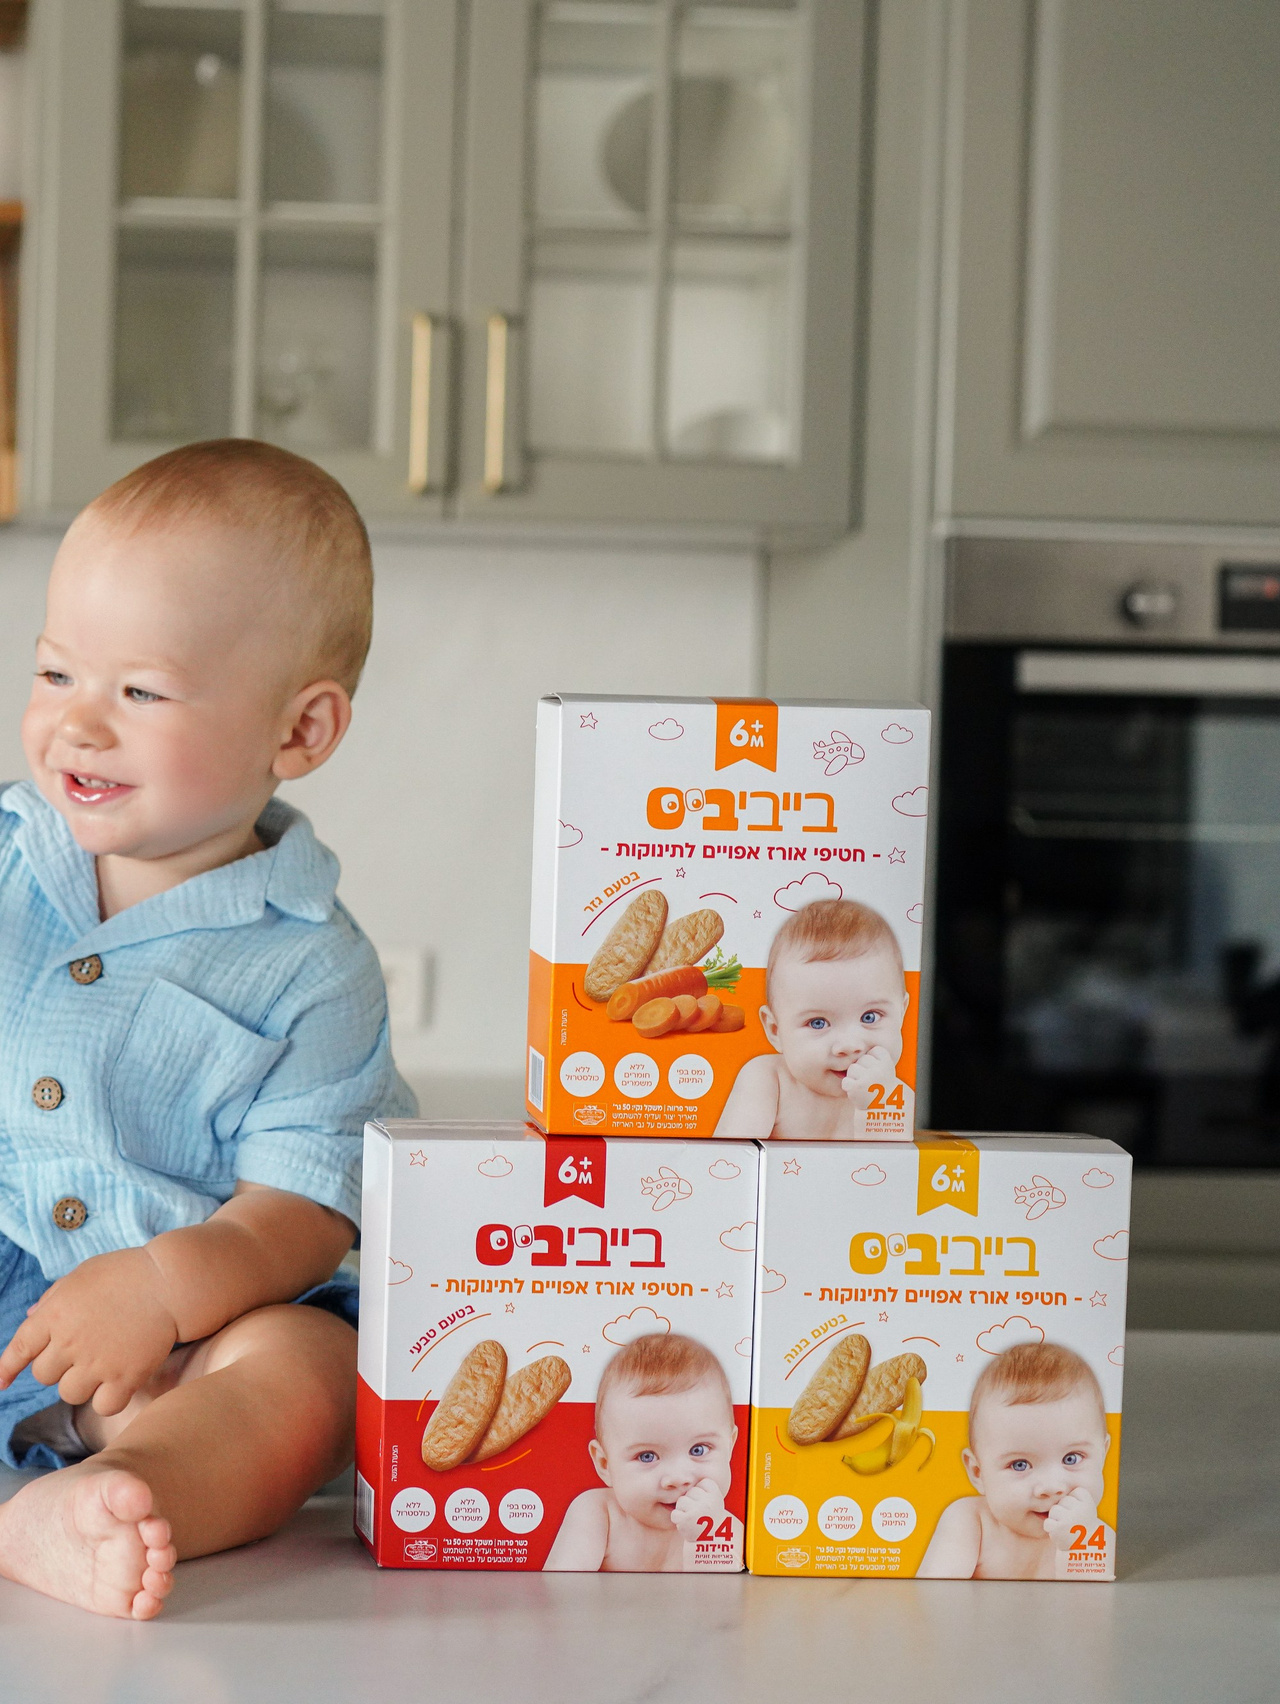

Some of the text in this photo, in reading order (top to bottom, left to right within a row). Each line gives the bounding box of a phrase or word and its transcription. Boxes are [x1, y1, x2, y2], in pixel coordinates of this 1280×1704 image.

[616, 842, 865, 862] חטיפי אורז אפויים לתינוקות
[584, 871, 640, 912] בטעם גזר
[678, 1077, 703, 1085] התינוק
[867, 1083, 904, 1109] 24
[867, 1112, 905, 1120] יחידות
[445, 1278, 694, 1296] חטיפי אורז אפויים לתינוקות
[819, 1287, 1067, 1306] חטיפי אורז אפויים לתינוקות
[409, 1304, 475, 1354] בטעם טבעי
[784, 1313, 848, 1363] בטעם בננה
[696, 1516, 733, 1541] 24
[1069, 1525, 1106, 1550] 24
[696, 1544, 733, 1552] יחידות
[1069, 1553, 1106, 1561] יחידות
